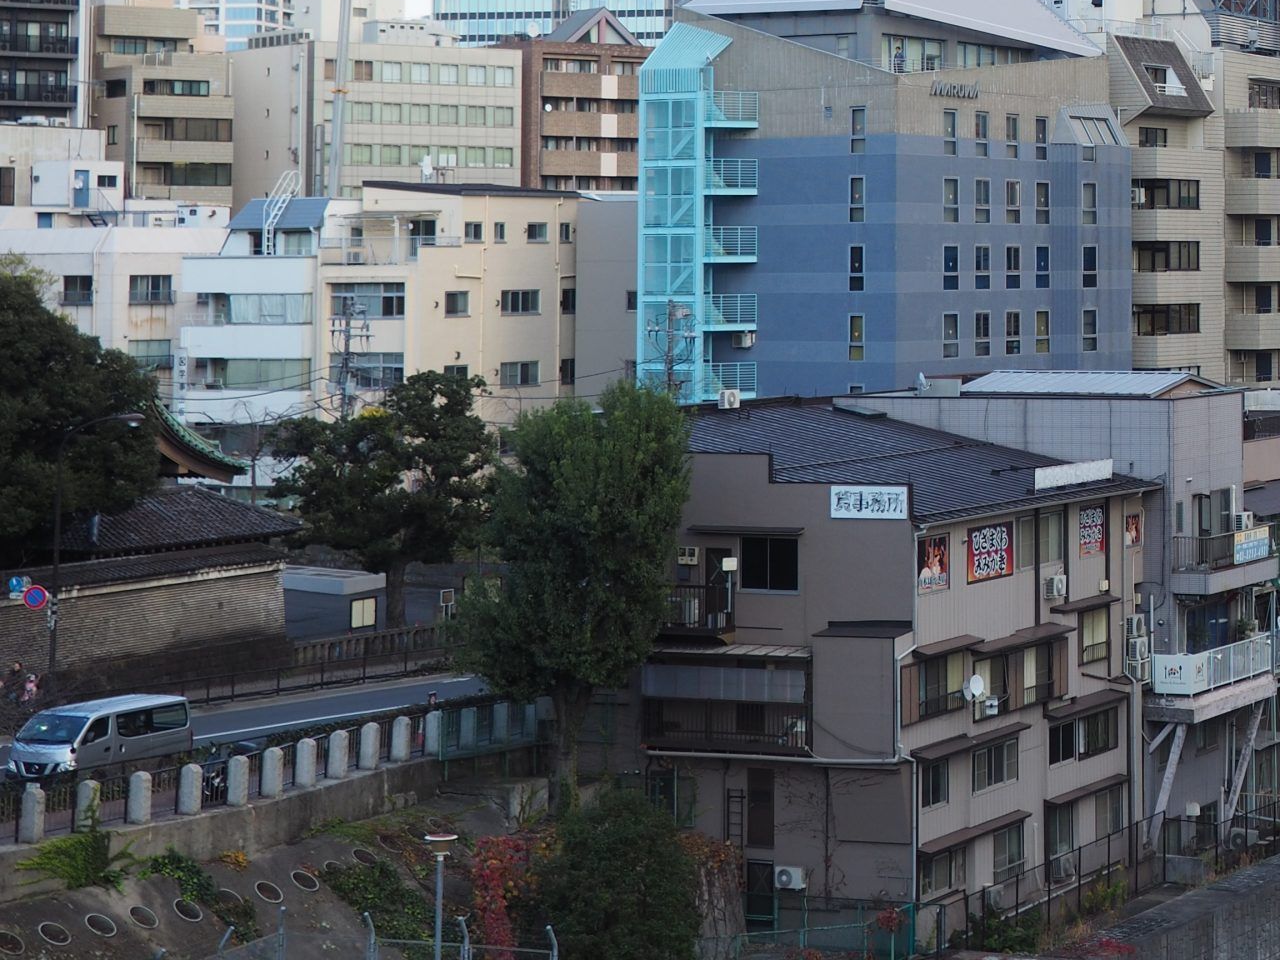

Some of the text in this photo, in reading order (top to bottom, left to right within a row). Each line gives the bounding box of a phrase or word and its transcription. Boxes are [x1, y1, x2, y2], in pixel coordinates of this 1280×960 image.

[931, 80, 980, 99] MARUWA
[972, 526, 1009, 554] ひざまくら
[973, 550, 1007, 578] みみかき
